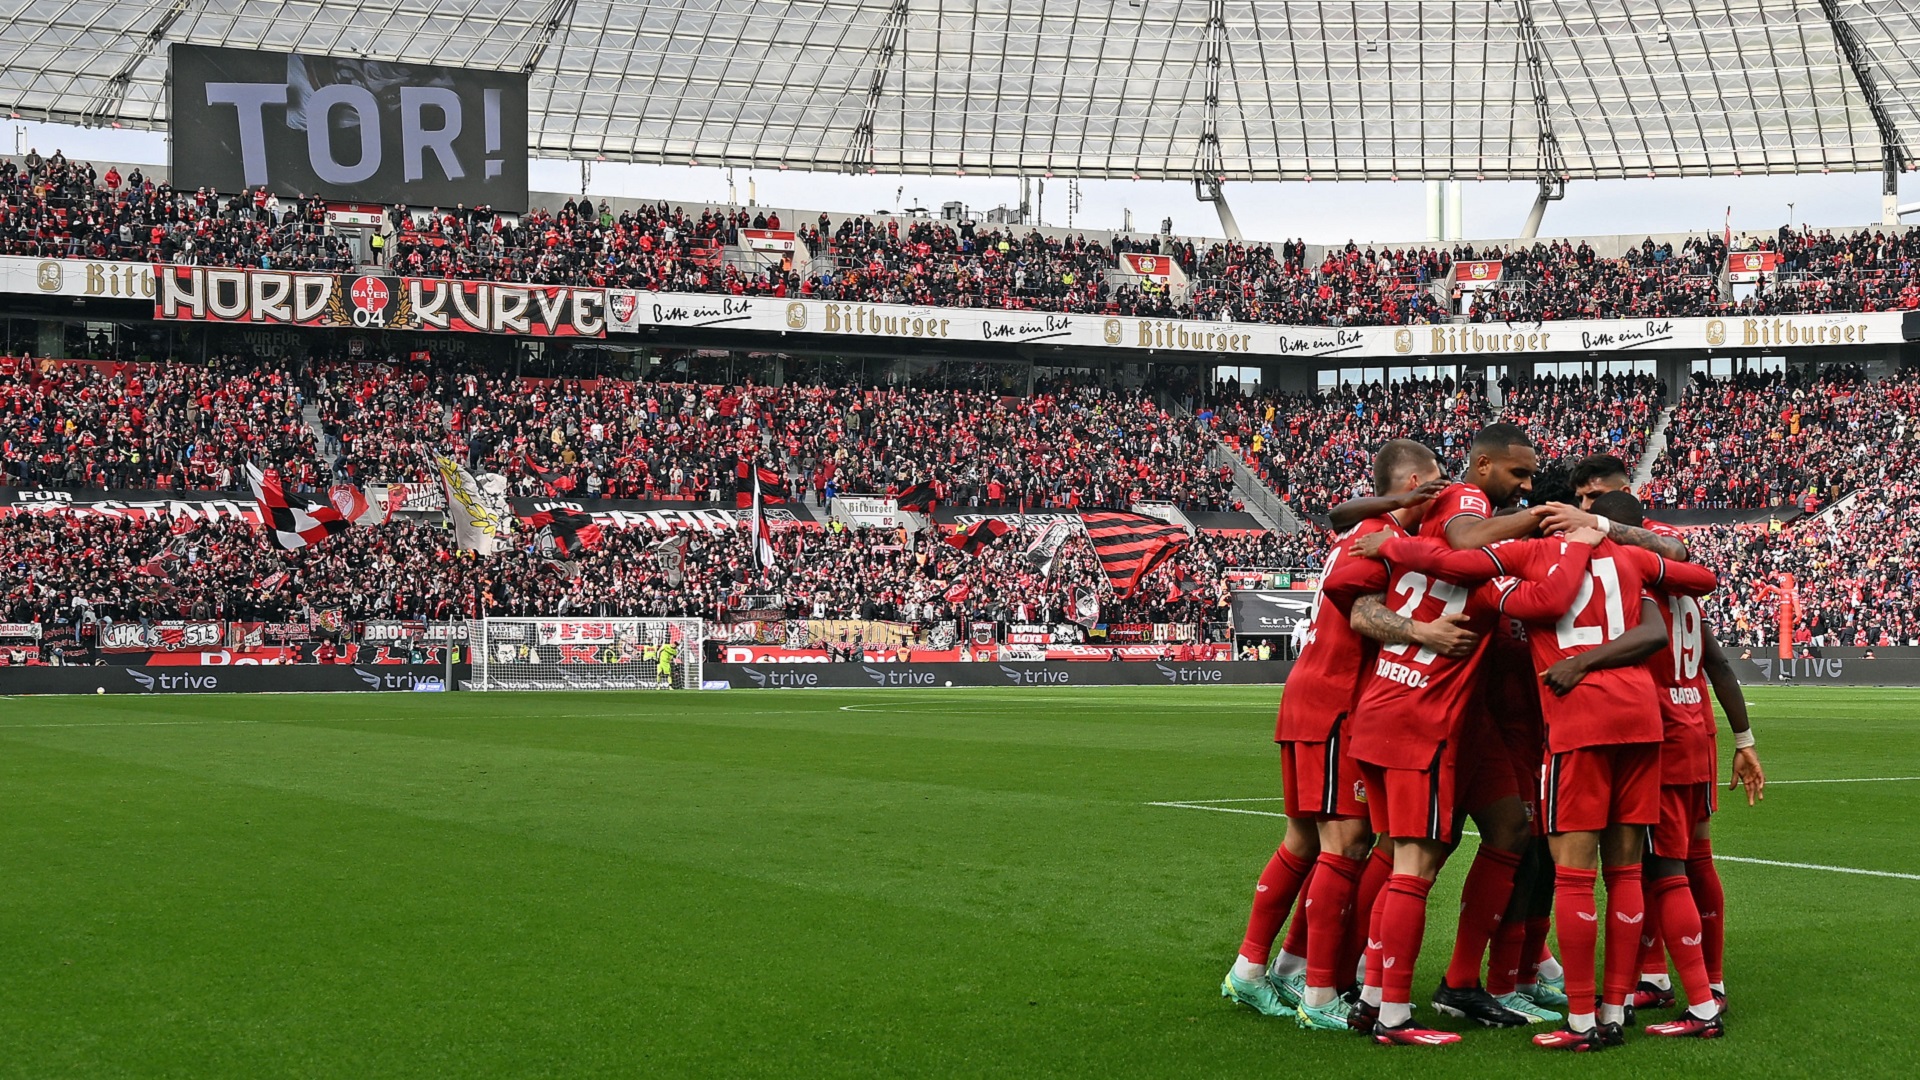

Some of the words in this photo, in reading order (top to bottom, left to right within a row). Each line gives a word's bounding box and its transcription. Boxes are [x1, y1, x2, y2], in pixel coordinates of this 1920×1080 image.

[205, 82, 505, 187] TOR!
[370, 215, 381, 224] D8
[783, 241, 793, 250] D7
[162, 266, 334, 322] NORD
[409, 279, 604, 336] KURVE
[352, 290, 388, 299] BAYER
[353, 307, 386, 328] 04
[693, 307, 720, 319] ein
[723, 298, 752, 316] Bit
[823, 303, 951, 337] Bitburger
[1019, 322, 1044, 334] ein
[1045, 315, 1072, 332] Bit
[243, 331, 271, 345] WIR
[272, 329, 301, 346] FÜR
[1137, 320, 1251, 352] Bitburger
[1311, 337, 1335, 349] ein
[1337, 329, 1364, 347] Bit
[1430, 325, 1551, 354] Bitburger
[1618, 331, 1644, 344] ein
[1645, 321, 1674, 338] Bit
[1742, 317, 1869, 346] Bitburger
[532, 501, 584, 513] UND
[849, 501, 893, 513] Bitburger
[1555, 556, 1625, 650] 21
[185, 622, 220, 647] 513
[1010, 624, 1048, 634] YOUNG
[1668, 594, 1702, 682] 19
[159, 672, 218, 689] trive
[384, 671, 439, 688] trive
[769, 669, 819, 686] trive
[888, 668, 936, 685] trive
[1023, 668, 1069, 683] trive
[1180, 666, 1222, 681] trive
